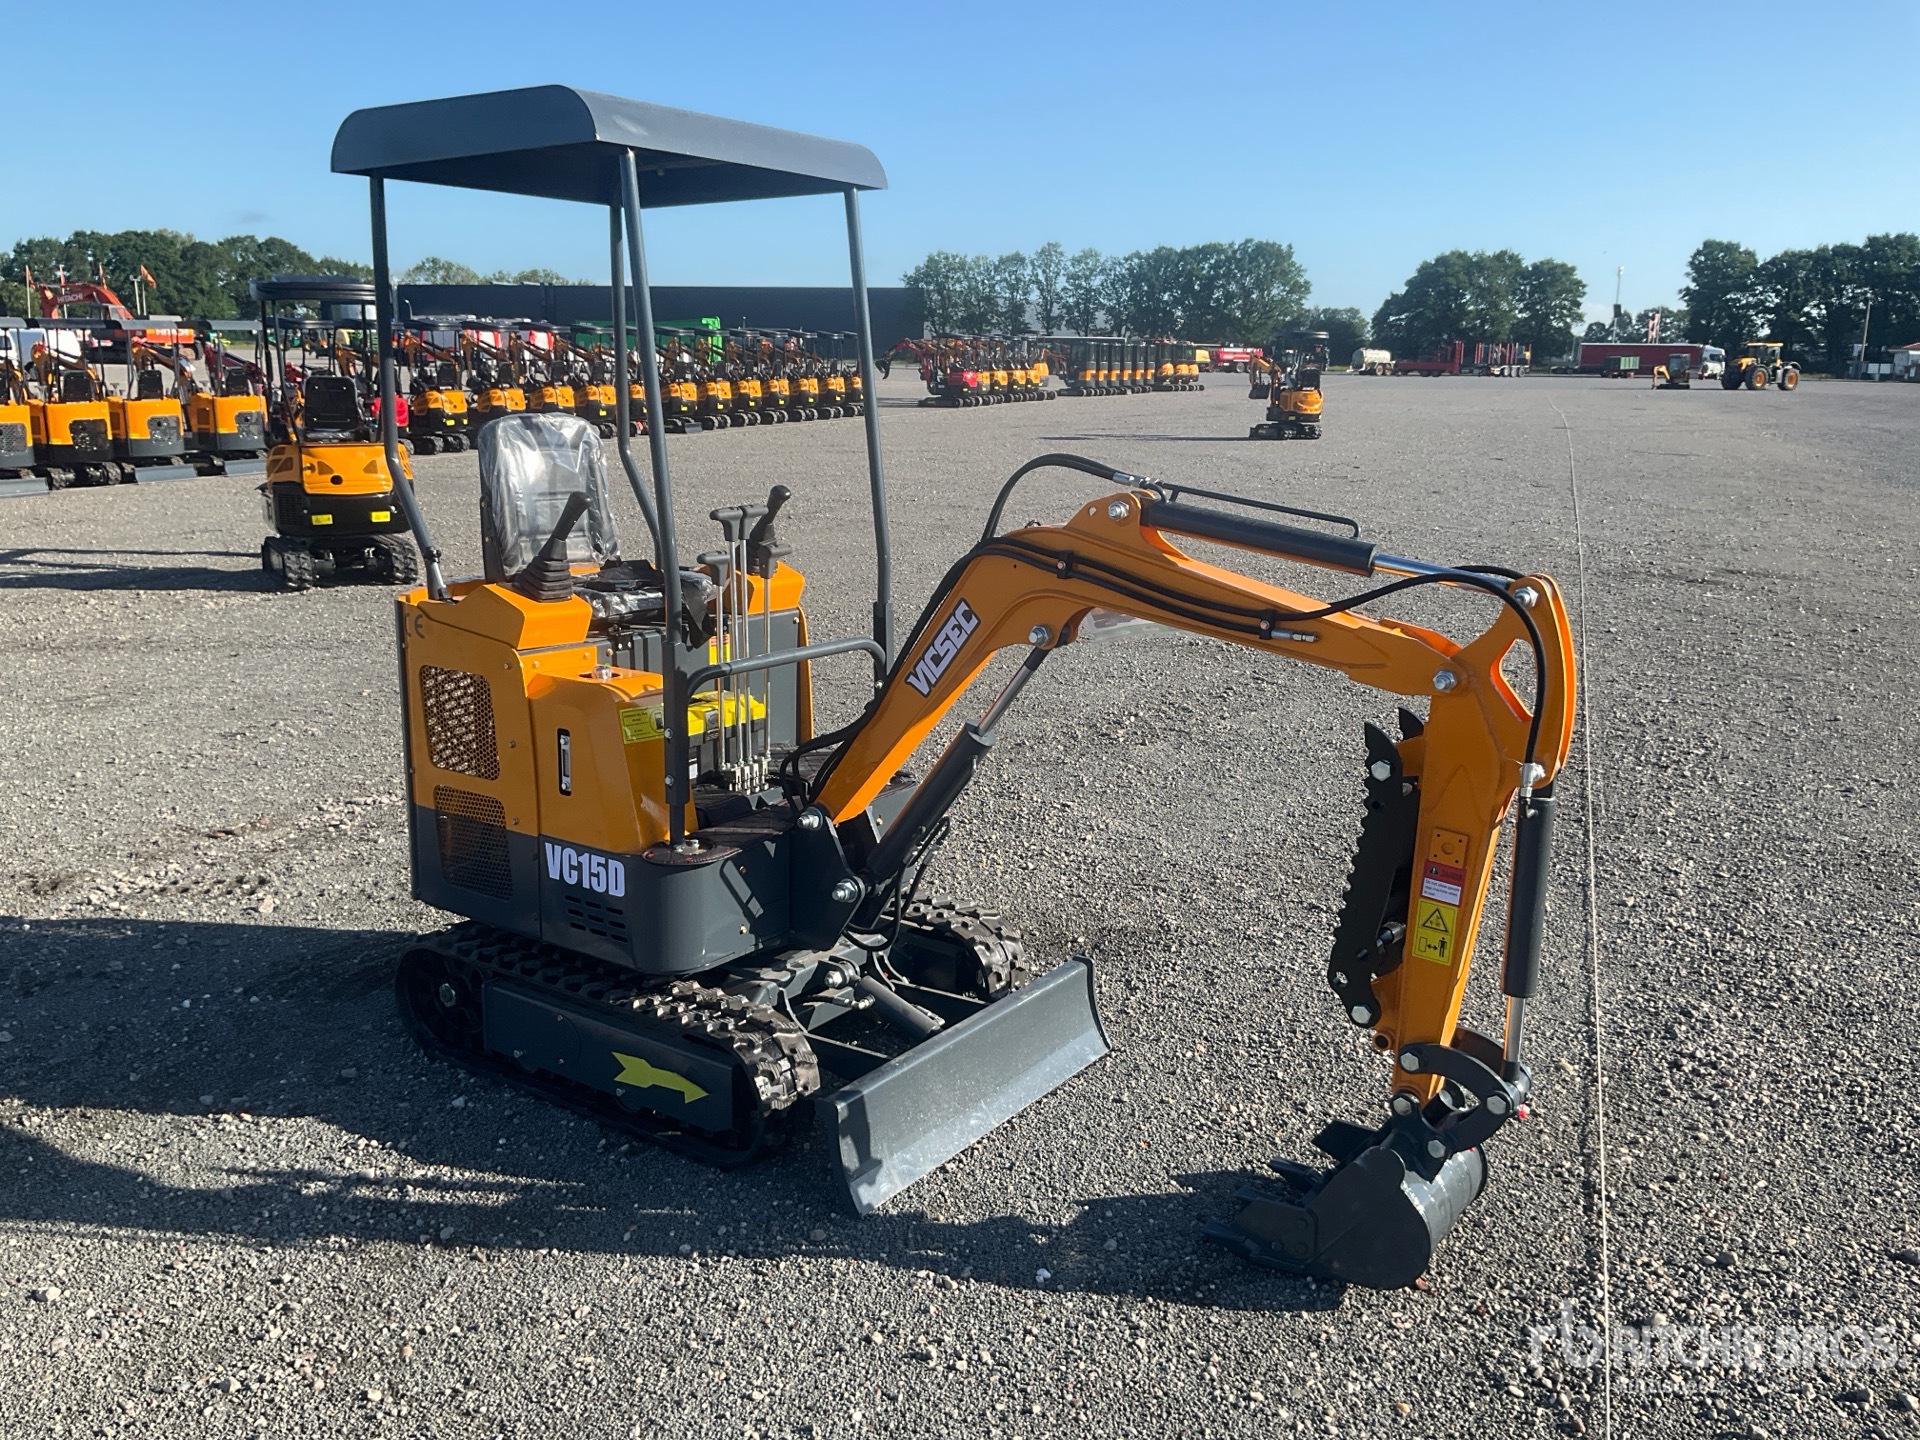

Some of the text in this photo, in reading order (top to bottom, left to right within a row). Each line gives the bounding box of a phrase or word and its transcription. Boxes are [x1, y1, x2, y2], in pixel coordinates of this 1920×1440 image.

[57, 293, 83, 304] HITACHI
[906, 599, 980, 697] VICSEC
[544, 842, 625, 897] VC15D
